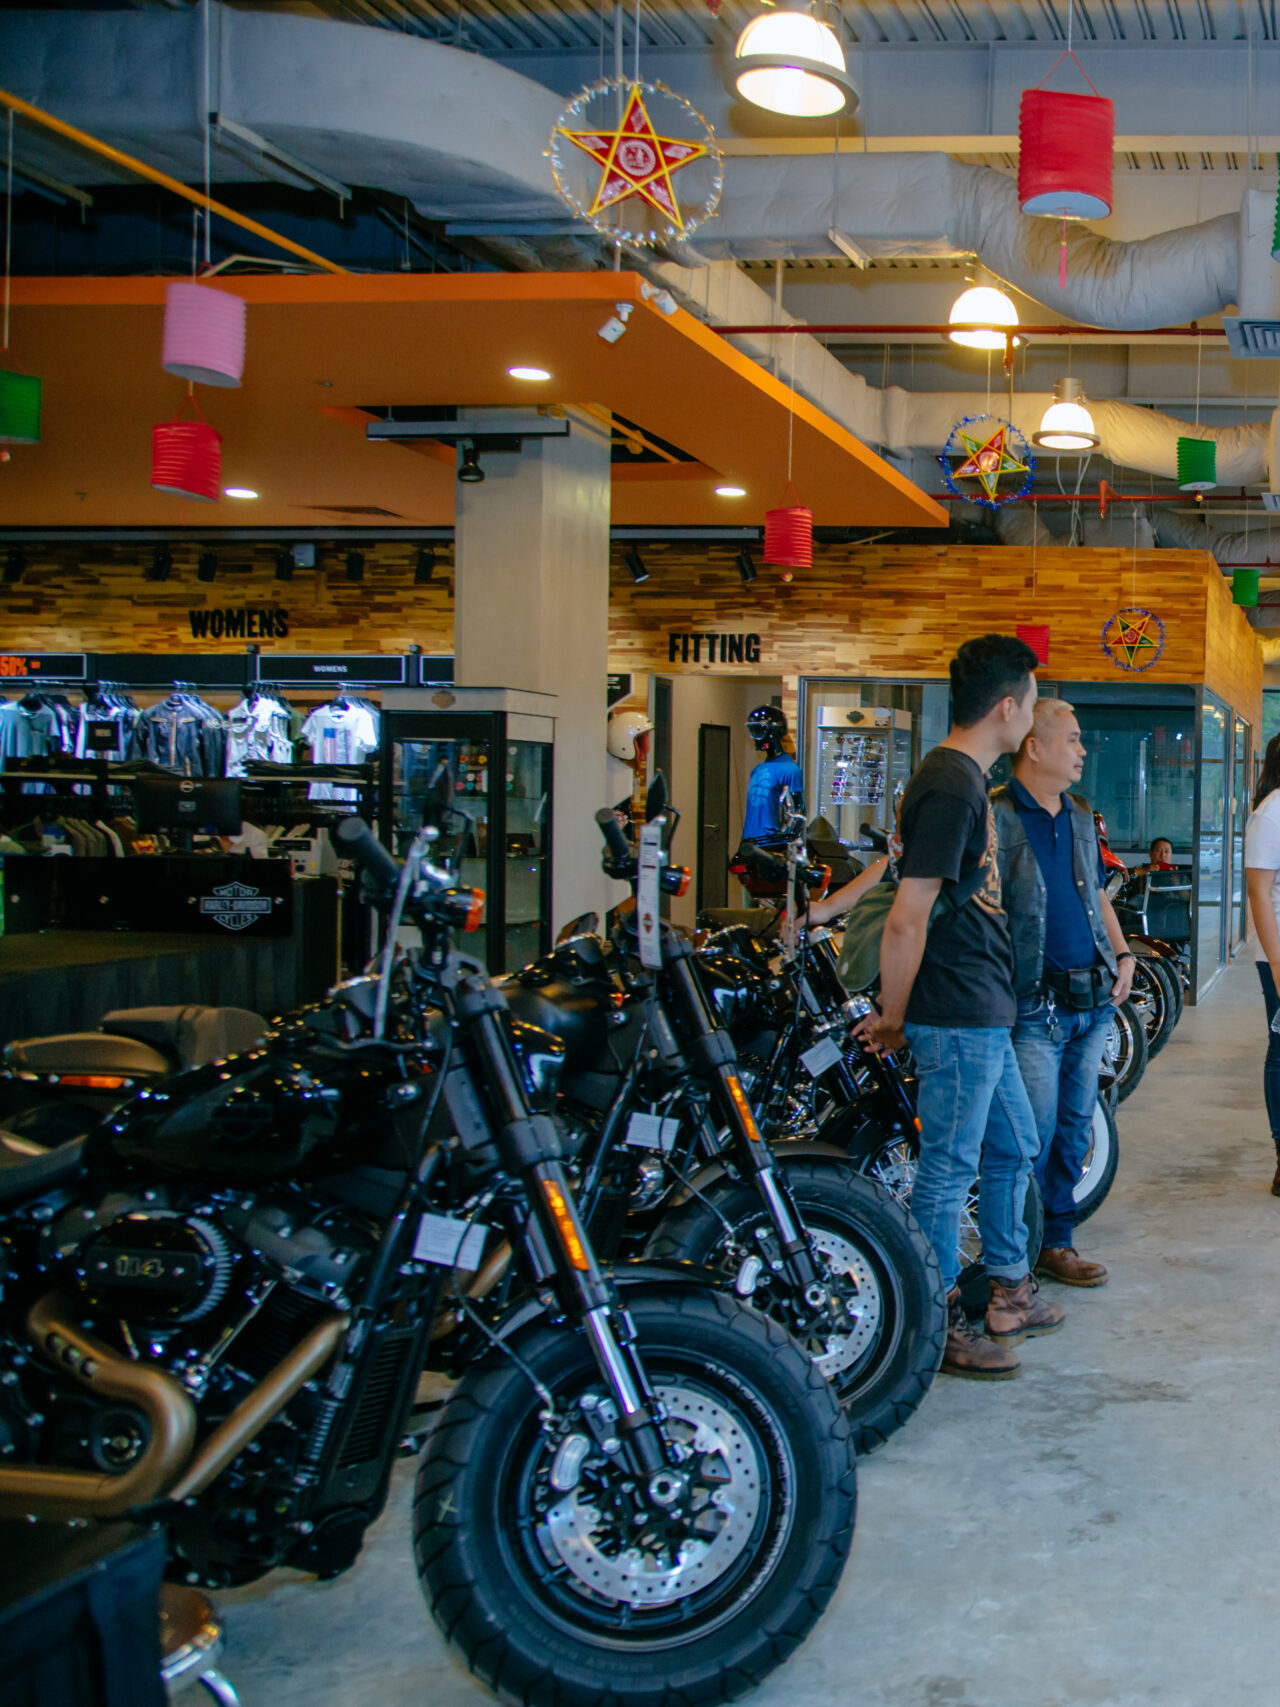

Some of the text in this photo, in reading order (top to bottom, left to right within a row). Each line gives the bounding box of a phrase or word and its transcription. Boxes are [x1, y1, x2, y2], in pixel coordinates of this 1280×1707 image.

[188, 608, 289, 638] WOMENS
[669, 633, 760, 663] FITTING
[0, 656, 28, 676] 50%
[313, 665, 348, 673] WOMENS
